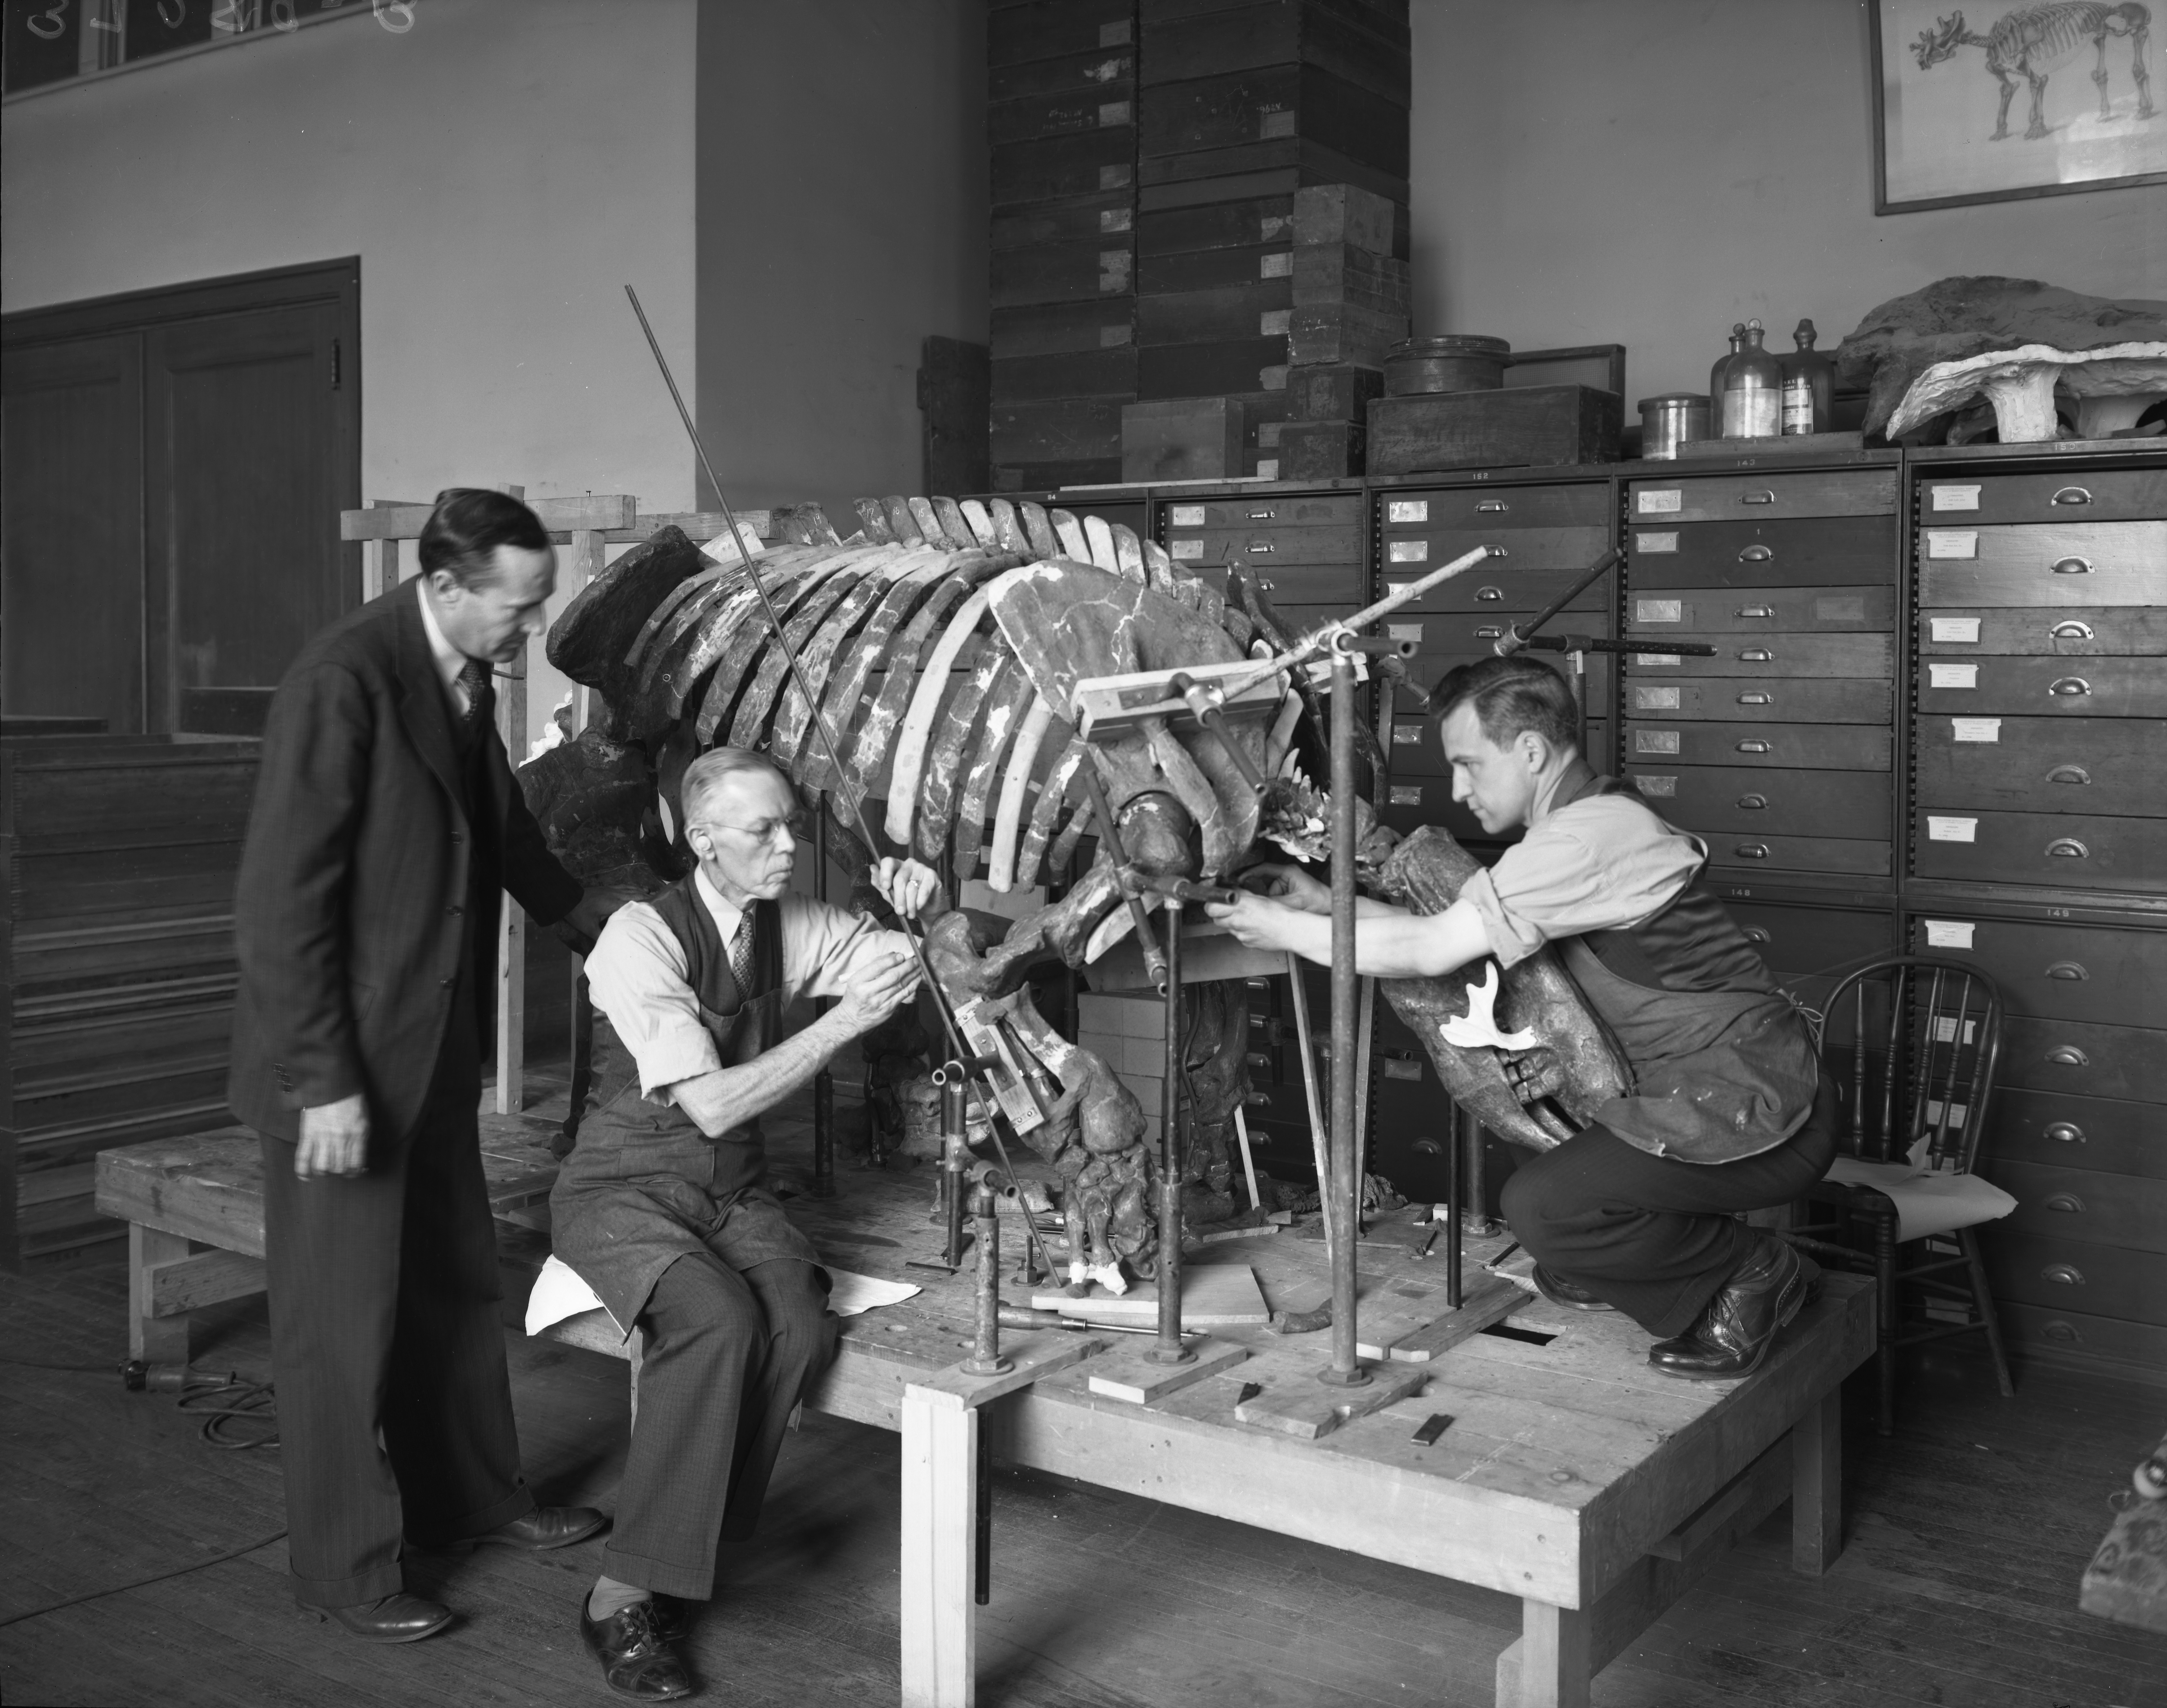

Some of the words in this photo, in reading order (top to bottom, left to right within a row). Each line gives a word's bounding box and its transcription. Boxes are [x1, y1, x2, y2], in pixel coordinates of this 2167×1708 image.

[867, 508, 874, 518] 17
[918, 507, 925, 518] 15
[2047, 909, 2069, 917] 149
